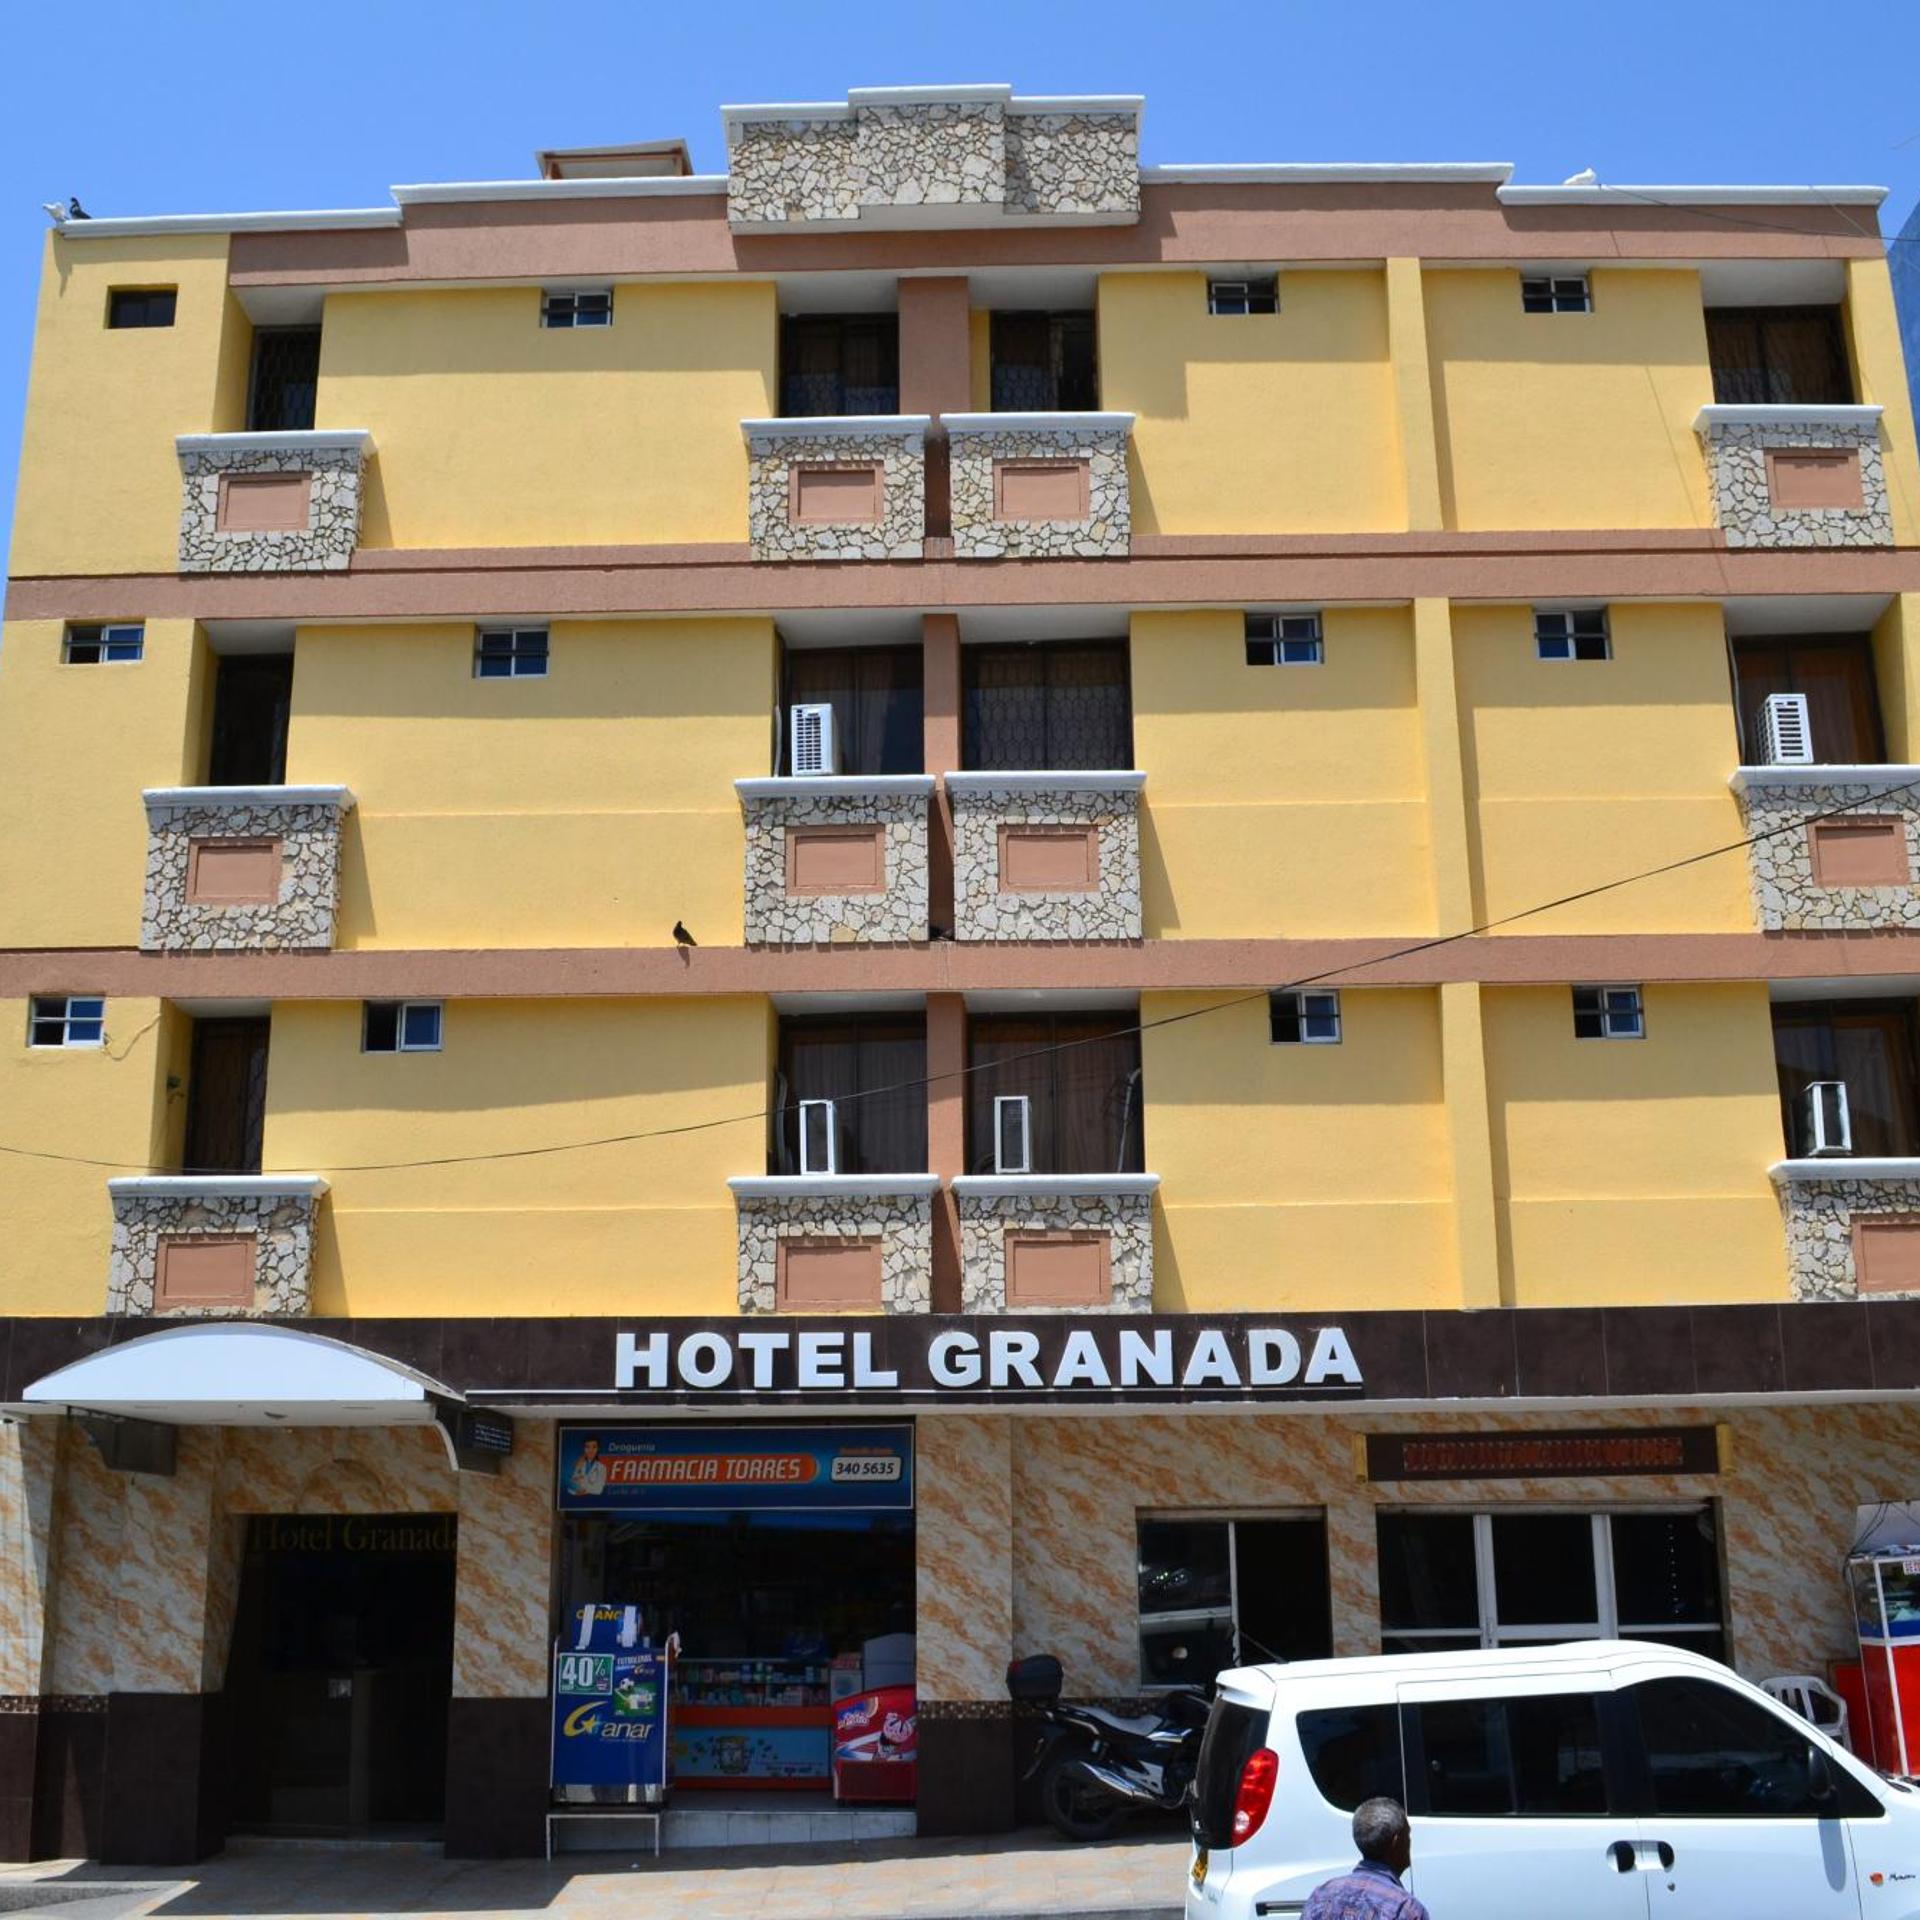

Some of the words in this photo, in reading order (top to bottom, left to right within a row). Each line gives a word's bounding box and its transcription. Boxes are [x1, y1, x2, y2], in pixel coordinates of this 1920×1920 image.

[615, 1332, 898, 1388] HOTEL
[928, 1327, 1363, 1387] GRANADA
[610, 1459, 718, 1481] FARMACIA
[726, 1458, 801, 1480] TORRES
[836, 1462, 860, 1475] 340
[862, 1462, 895, 1475] 5635
[252, 1515, 333, 1551] Hotel
